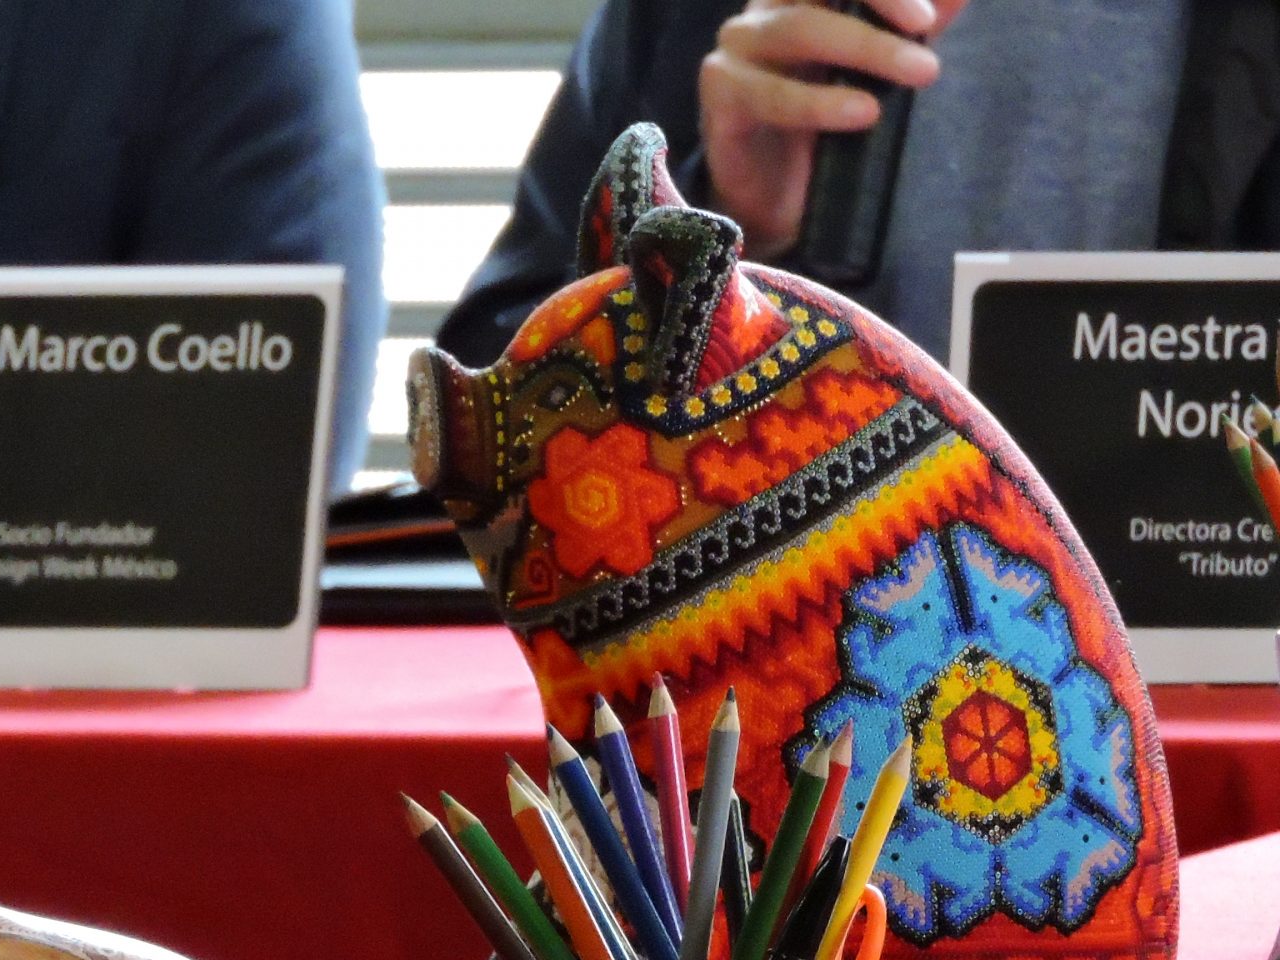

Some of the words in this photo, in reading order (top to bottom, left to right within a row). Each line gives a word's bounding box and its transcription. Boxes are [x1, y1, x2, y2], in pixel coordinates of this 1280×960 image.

[146, 321, 293, 373] Coello
[1072, 312, 1268, 361] Maestra
[1129, 517, 1232, 542] Directora
